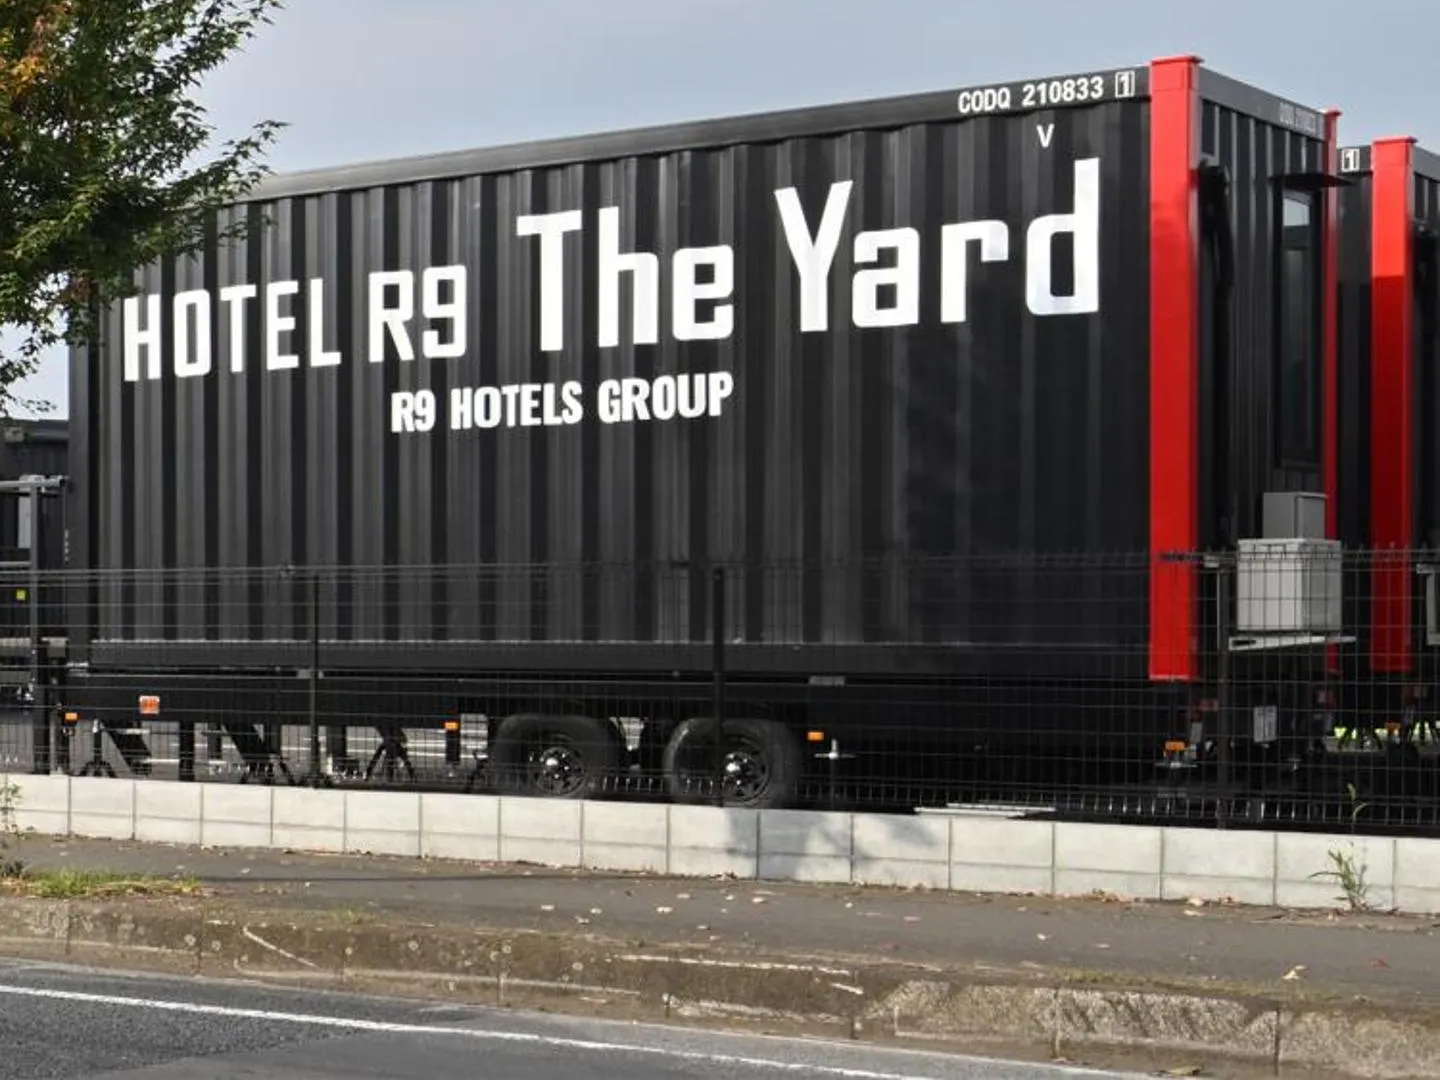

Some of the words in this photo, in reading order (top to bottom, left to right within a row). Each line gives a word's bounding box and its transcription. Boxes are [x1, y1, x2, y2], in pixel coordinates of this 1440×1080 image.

[1022, 76, 1104, 107] 210833
[1036, 123, 1055, 148] V
[123, 278, 342, 381] HOTEL
[369, 265, 467, 363] R9
[516, 205, 734, 351] The
[774, 158, 1099, 332] Yard
[391, 390, 435, 433] R9
[451, 381, 584, 429] HOTELS
[598, 372, 734, 423] GROUP
